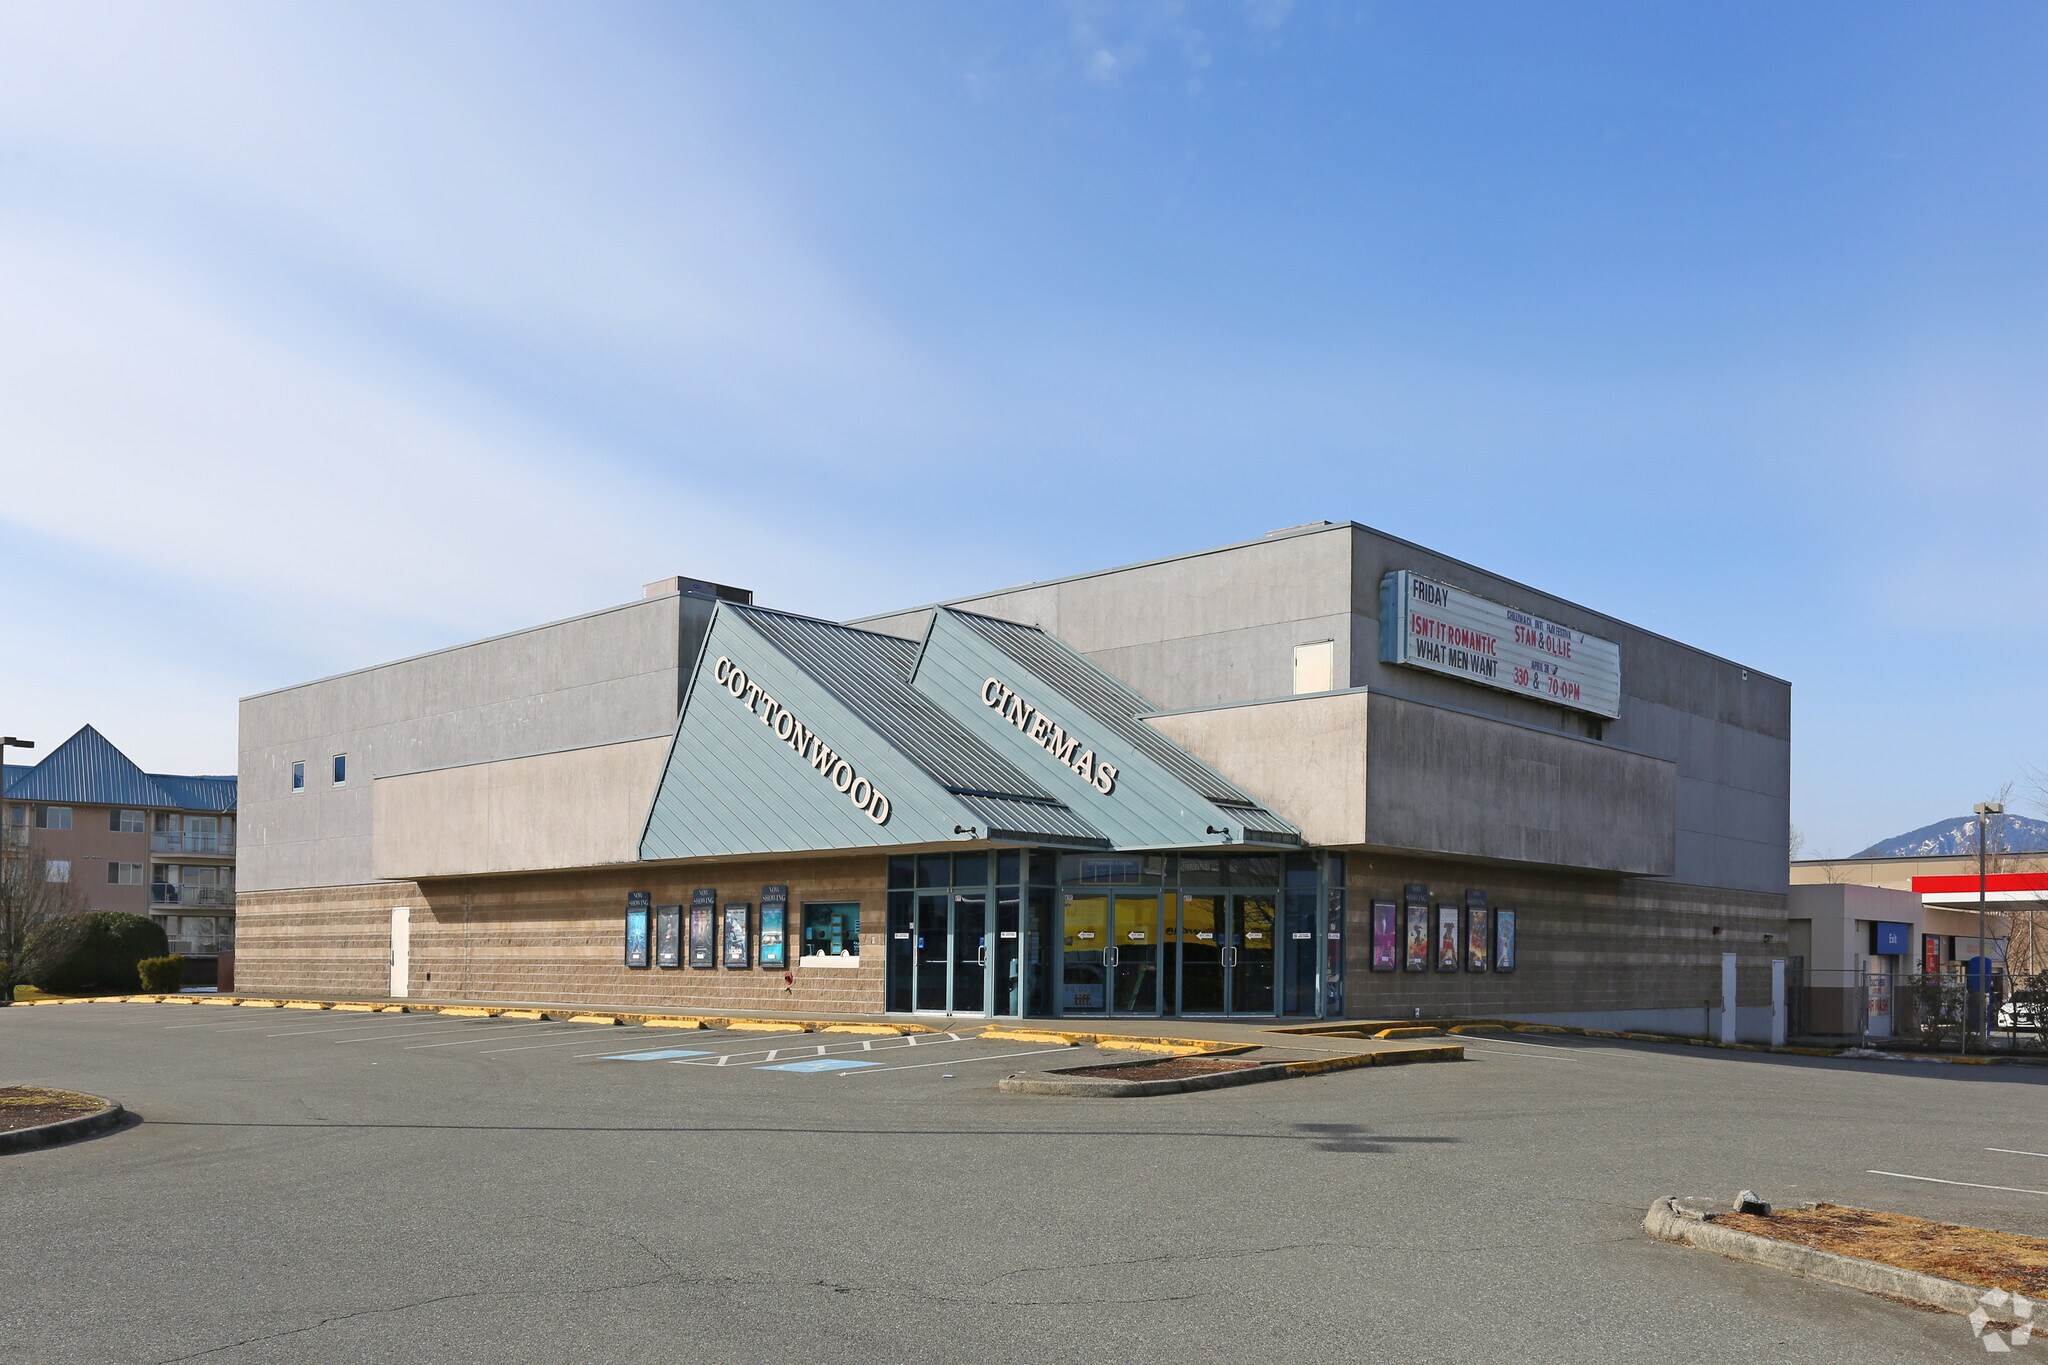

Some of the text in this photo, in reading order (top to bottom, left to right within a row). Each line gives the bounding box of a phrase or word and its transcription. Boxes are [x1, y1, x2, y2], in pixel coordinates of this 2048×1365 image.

[1413, 579, 1448, 607] FRIDAY
[1412, 613, 1497, 656] ISNT IT ROMANTIC
[1515, 624, 1571, 659] STAN & OLLIE
[1416, 638, 1498, 678] WHAT MEN WANT
[1513, 666, 1529, 687] 330
[1533, 672, 1540, 690] &
[714, 655, 890, 826] COTTONWOOD
[981, 677, 1118, 795] CINEMAS
[1888, 933, 1898, 944] Exit
